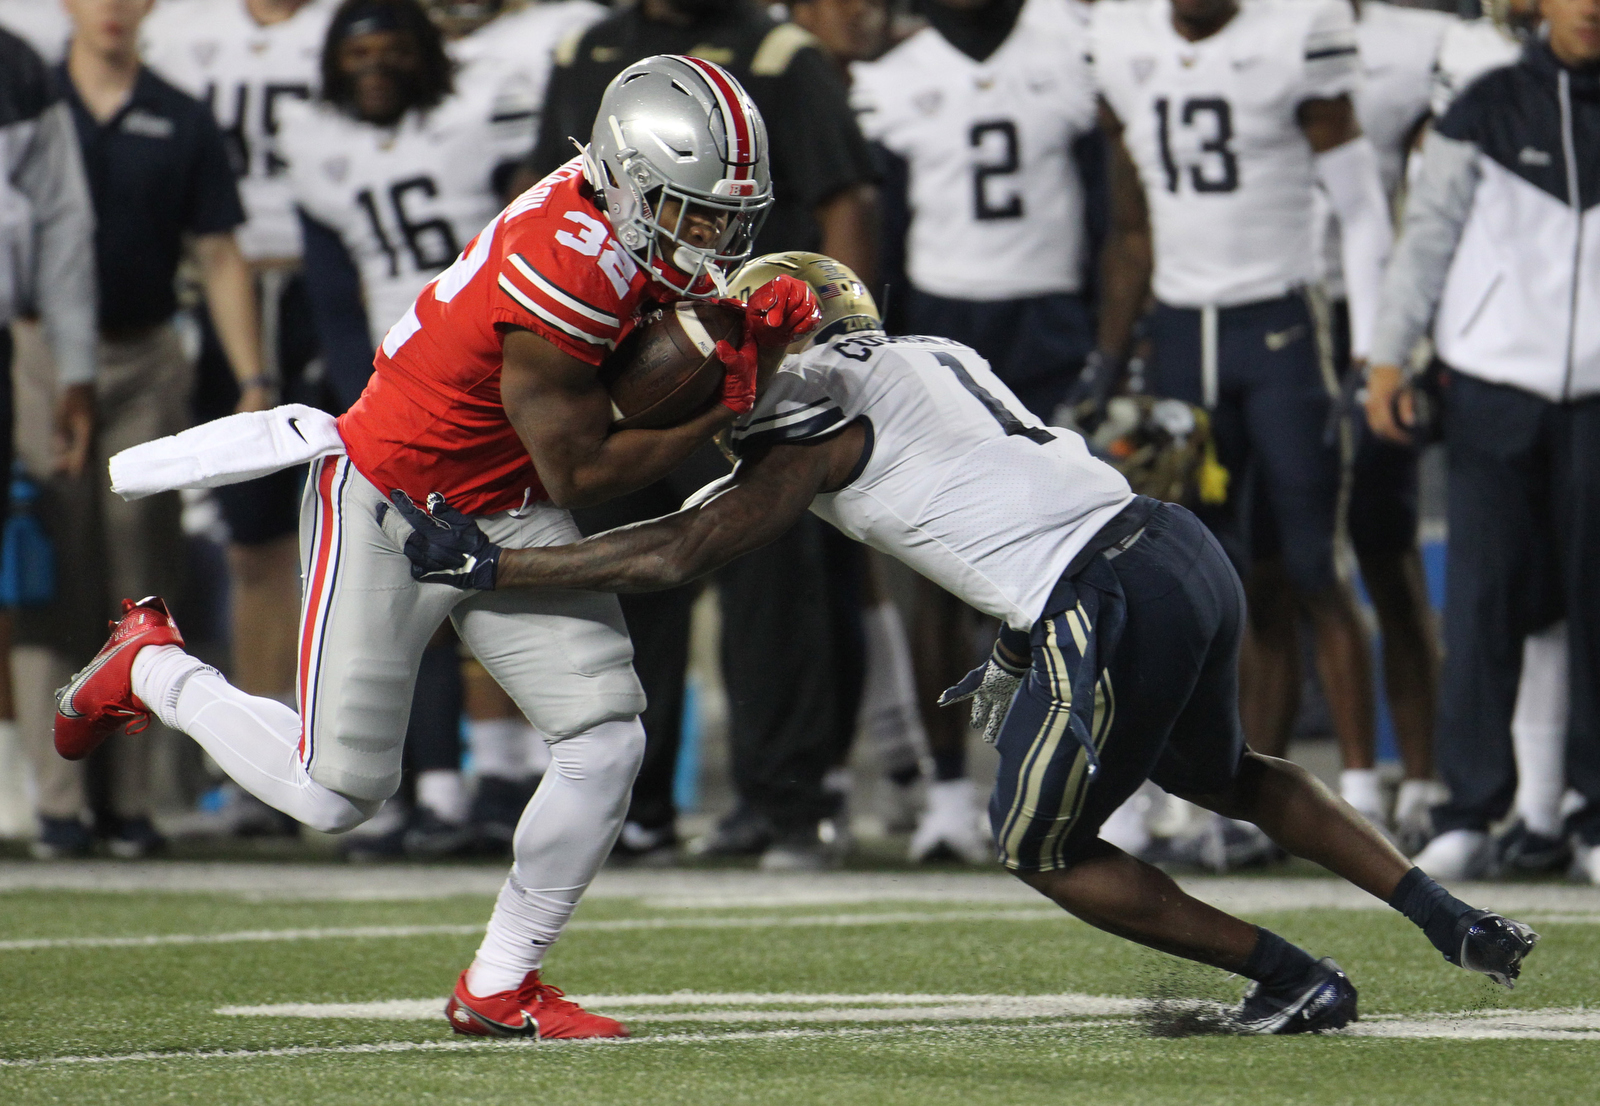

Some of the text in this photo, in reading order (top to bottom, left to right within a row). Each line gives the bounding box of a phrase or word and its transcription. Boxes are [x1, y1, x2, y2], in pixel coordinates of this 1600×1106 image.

[967, 118, 1024, 219] 2
[1153, 96, 1240, 194] 13
[356, 175, 461, 278] 16
[553, 210, 638, 300] 32
[928, 351, 1058, 446] 1
